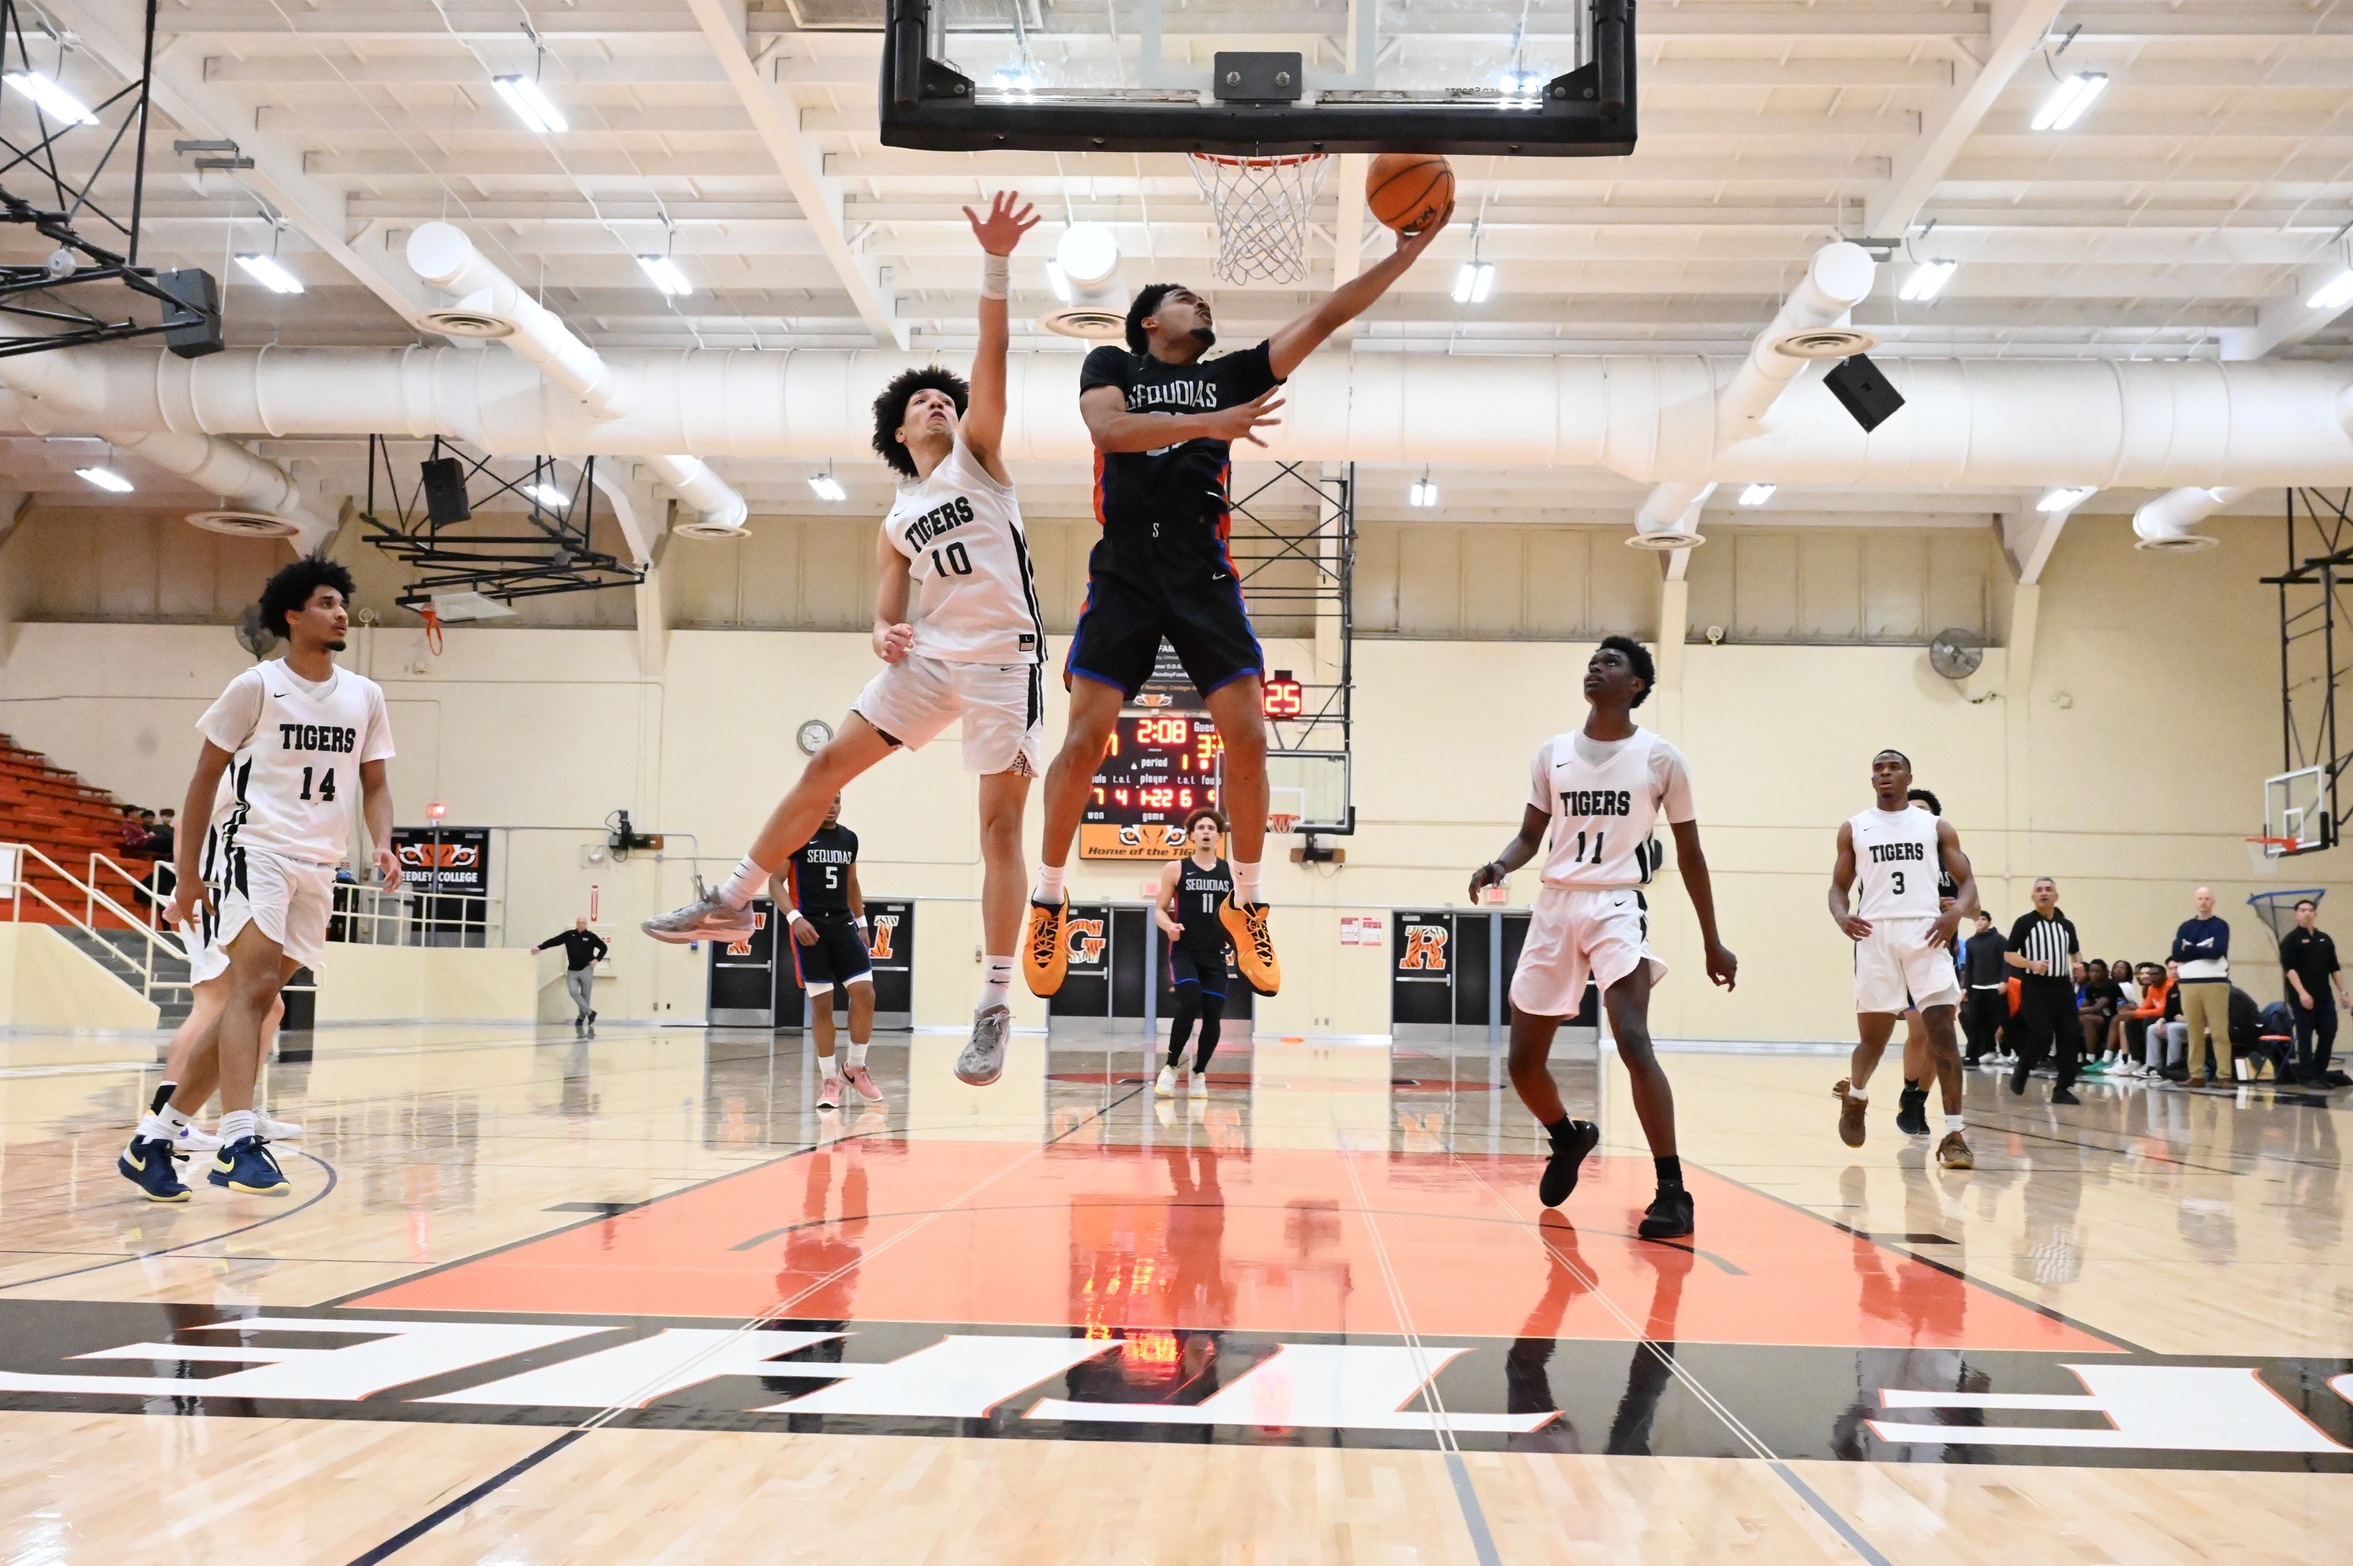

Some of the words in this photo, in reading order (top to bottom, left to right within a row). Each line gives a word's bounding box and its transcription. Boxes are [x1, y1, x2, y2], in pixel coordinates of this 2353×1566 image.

[905, 496, 974, 553] TIGERS
[1152, 522, 1160, 538] S
[932, 541, 973, 578] 10
[1265, 684, 1301, 713] 25
[1137, 719, 1186, 743] 2:08
[1193, 721, 1215, 733] Gues
[279, 724, 356, 753] TIGERS
[1140, 757, 1168, 769] period
[300, 767, 335, 802] 14
[1139, 773, 1168, 786] player
[1115, 788, 1128, 806] 4
[1180, 789, 1192, 807] 6
[1560, 790, 1631, 816] TIGERS
[1087, 811, 1105, 820] won
[1142, 812, 1164, 823] game
[807, 849, 853, 865] SEQUOIAS
[1088, 846, 1126, 856] Home
[1128, 847, 1143, 856] of
[1146, 847, 1169, 857] the
[1575, 831, 1604, 864] 11
[1869, 843, 1924, 863] TIGERS
[402, 871, 433, 882] EEDLEY
[437, 872, 478, 883] COLLEGE
[825, 866, 838, 889] 5
[1185, 878, 1230, 892] SEQUOIAS
[1891, 871, 1905, 895] 3
[1202, 893, 1214, 914] 11
[1399, 925, 1449, 970] R
